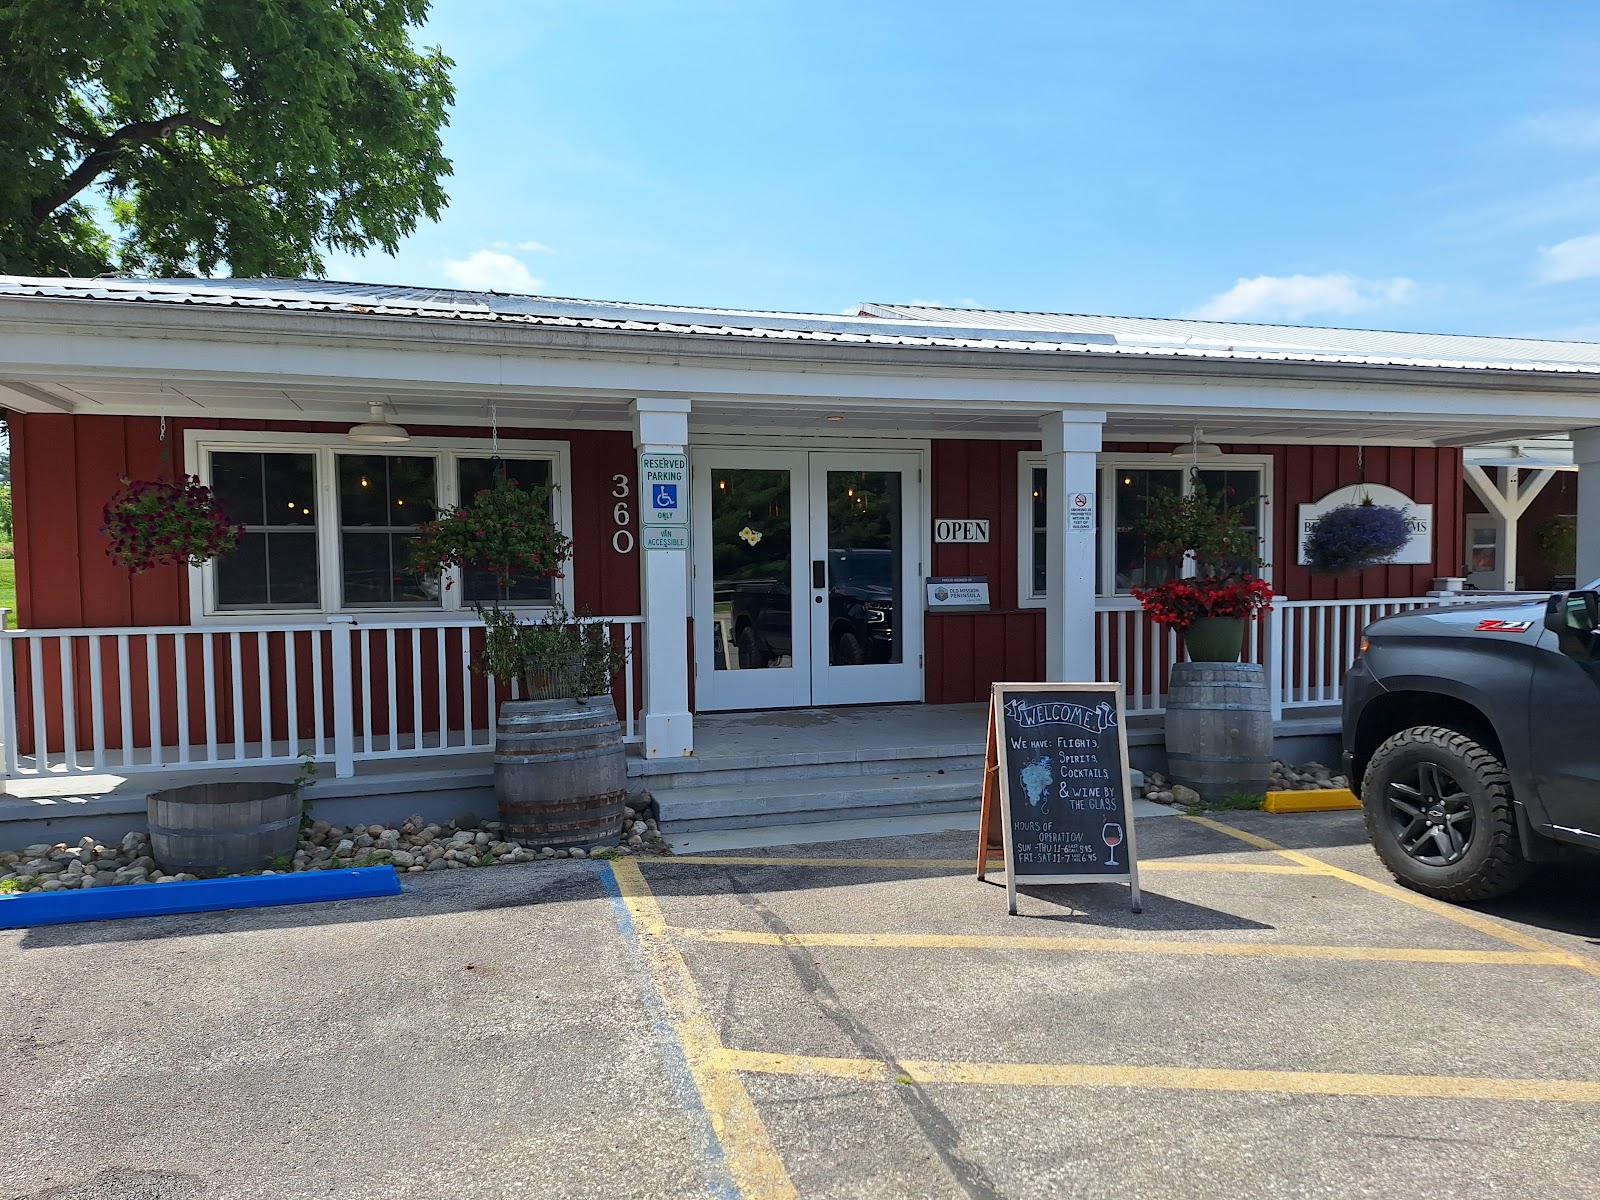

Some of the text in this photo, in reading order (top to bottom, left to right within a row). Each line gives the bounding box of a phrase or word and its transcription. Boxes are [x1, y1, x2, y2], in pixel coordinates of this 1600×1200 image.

[643, 459, 685, 469] RESERVED
[647, 471, 682, 481] PARKING
[611, 473, 635, 554] 360
[660, 530, 672, 538] VAN
[936, 521, 989, 541] OPEN
[647, 538, 684, 546] ACCESSIBLE
[1474, 619, 1534, 633] Z71
[1023, 704, 1094, 728] WELCOME
[1059, 781, 1115, 798] & WINE BY
[1069, 798, 1117, 811] THE GLASS
[1014, 821, 1053, 832] HOURS OF
[1038, 832, 1084, 842] OPERATION
[1017, 843, 1032, 853] SUN
